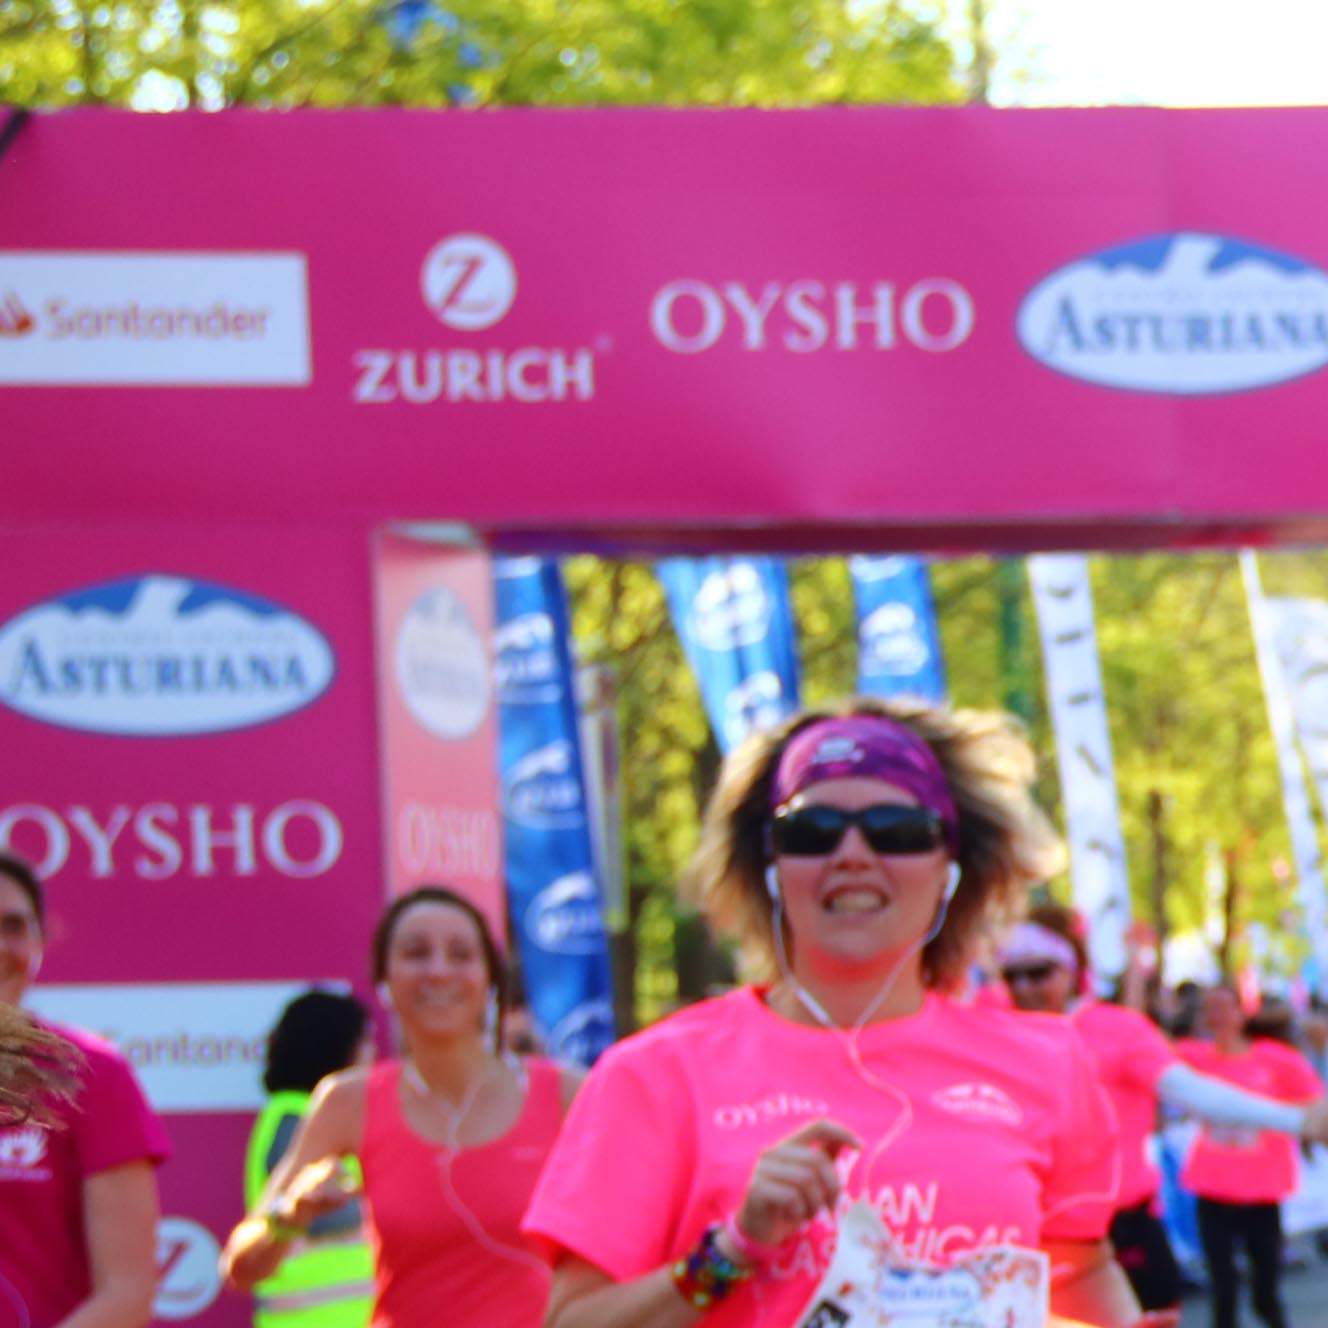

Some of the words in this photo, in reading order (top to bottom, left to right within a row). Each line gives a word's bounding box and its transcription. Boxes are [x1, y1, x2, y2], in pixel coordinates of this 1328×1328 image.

[45, 299, 269, 342] Santander
[650, 279, 975, 351] OYSHO
[354, 350, 593, 402] ZURICH
[8, 640, 309, 696] ASTURIANA
